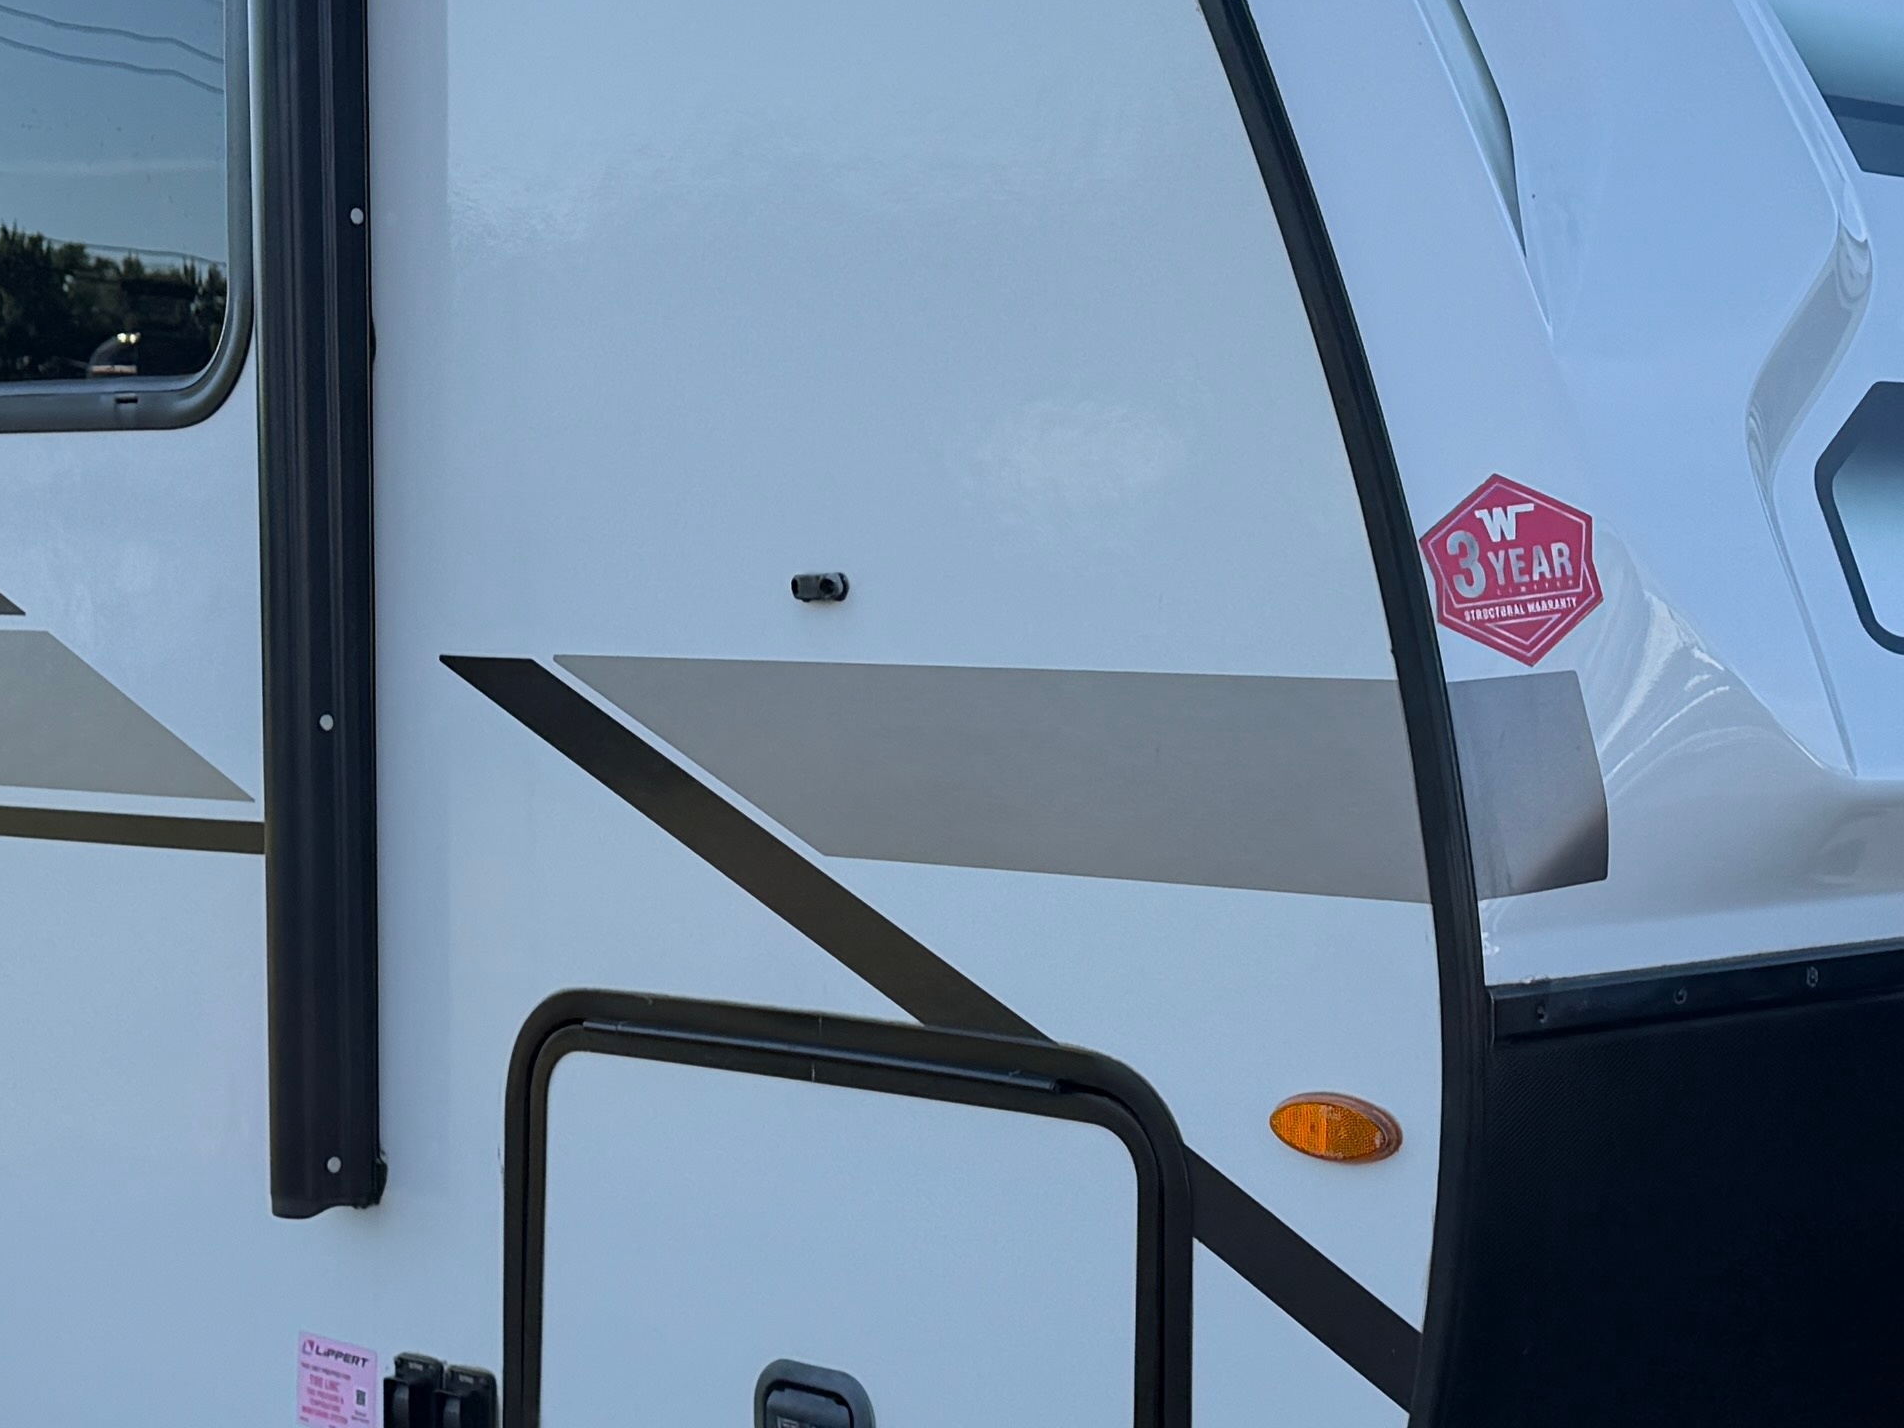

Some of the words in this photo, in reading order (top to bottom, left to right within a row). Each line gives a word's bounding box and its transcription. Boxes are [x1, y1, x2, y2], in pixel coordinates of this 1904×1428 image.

[1446, 530, 1487, 599] 3
[1487, 542, 1574, 586] YEAR
[1463, 602, 1526, 622] STRUCTURAL
[1527, 595, 1577, 616] WARRANTY
